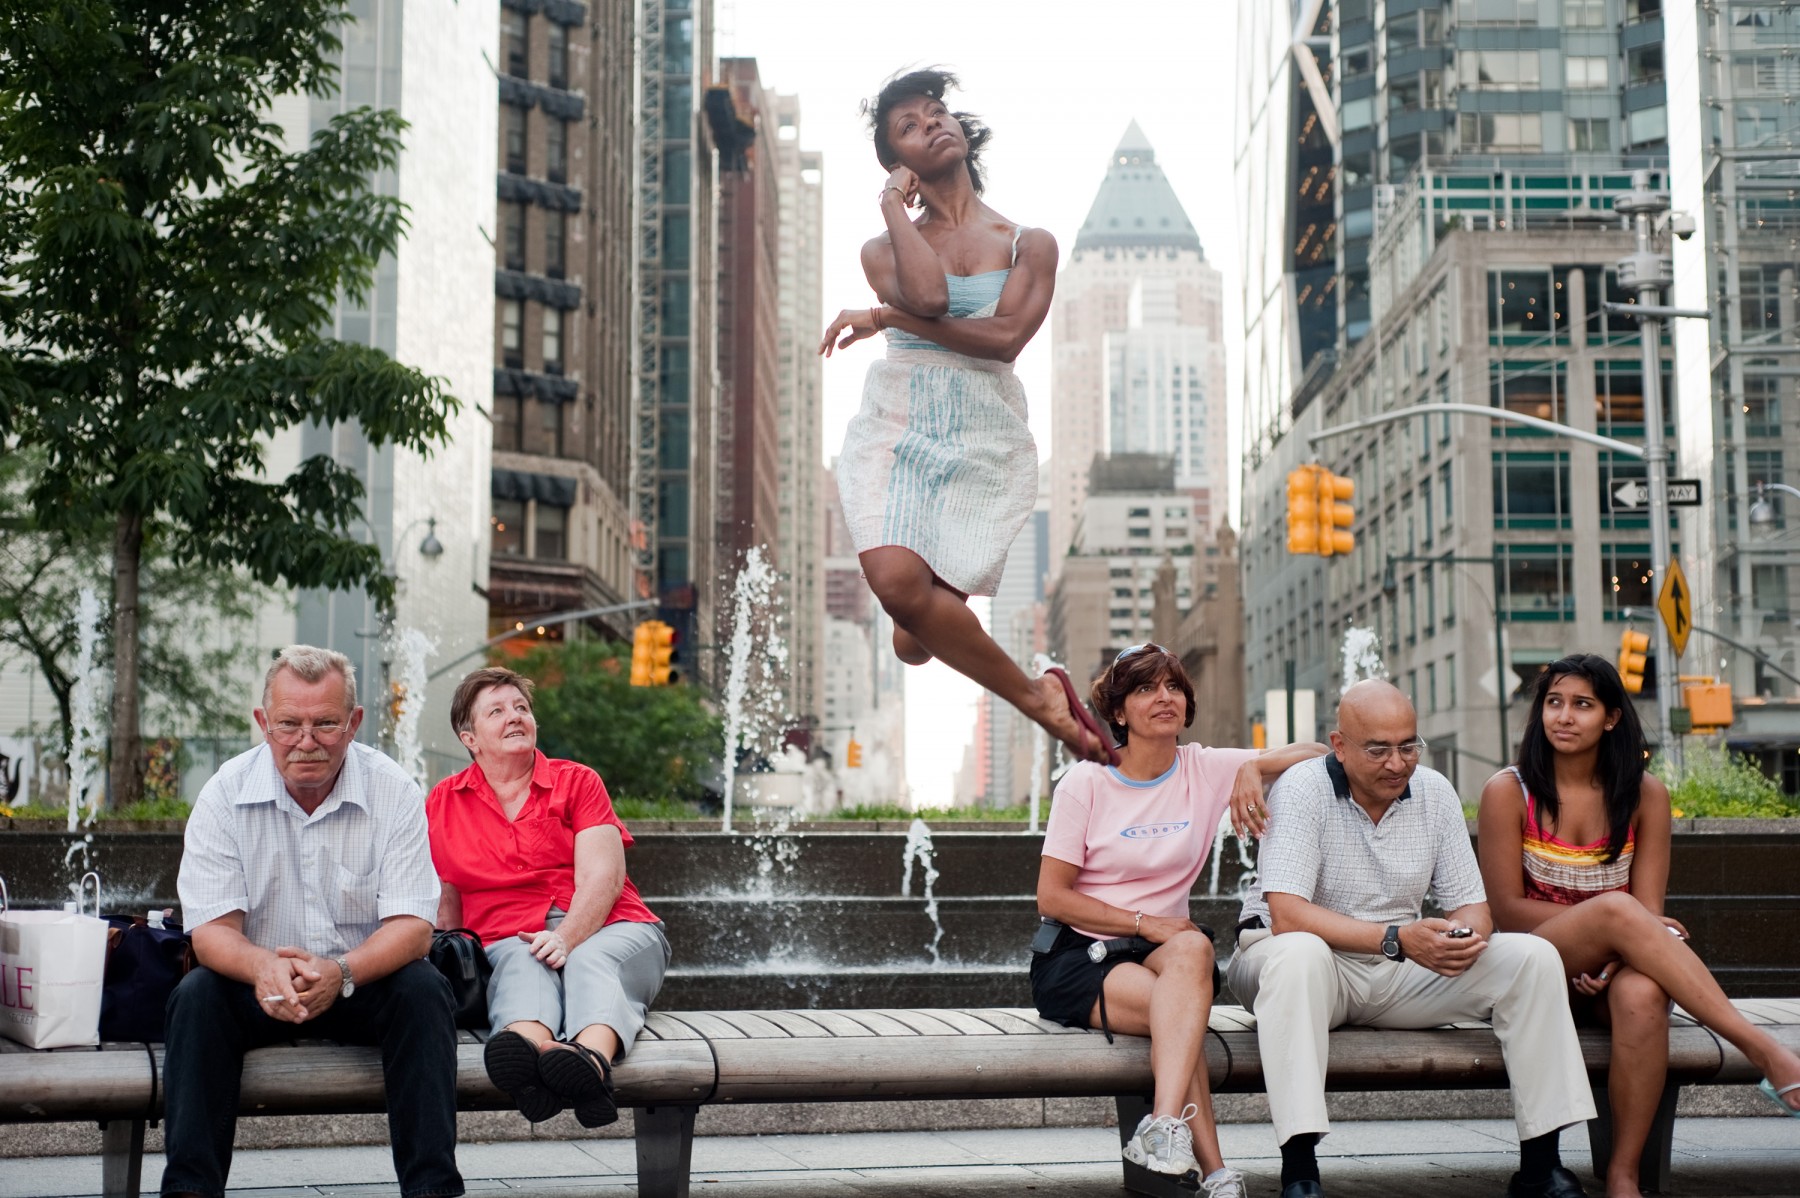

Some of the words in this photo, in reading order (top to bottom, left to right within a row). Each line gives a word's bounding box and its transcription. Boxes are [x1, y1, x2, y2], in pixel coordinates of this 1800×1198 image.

[1667, 488, 1692, 497] WAY
[1131, 825, 1179, 835] aspen
[9, 1012, 34, 1024] SECRET
